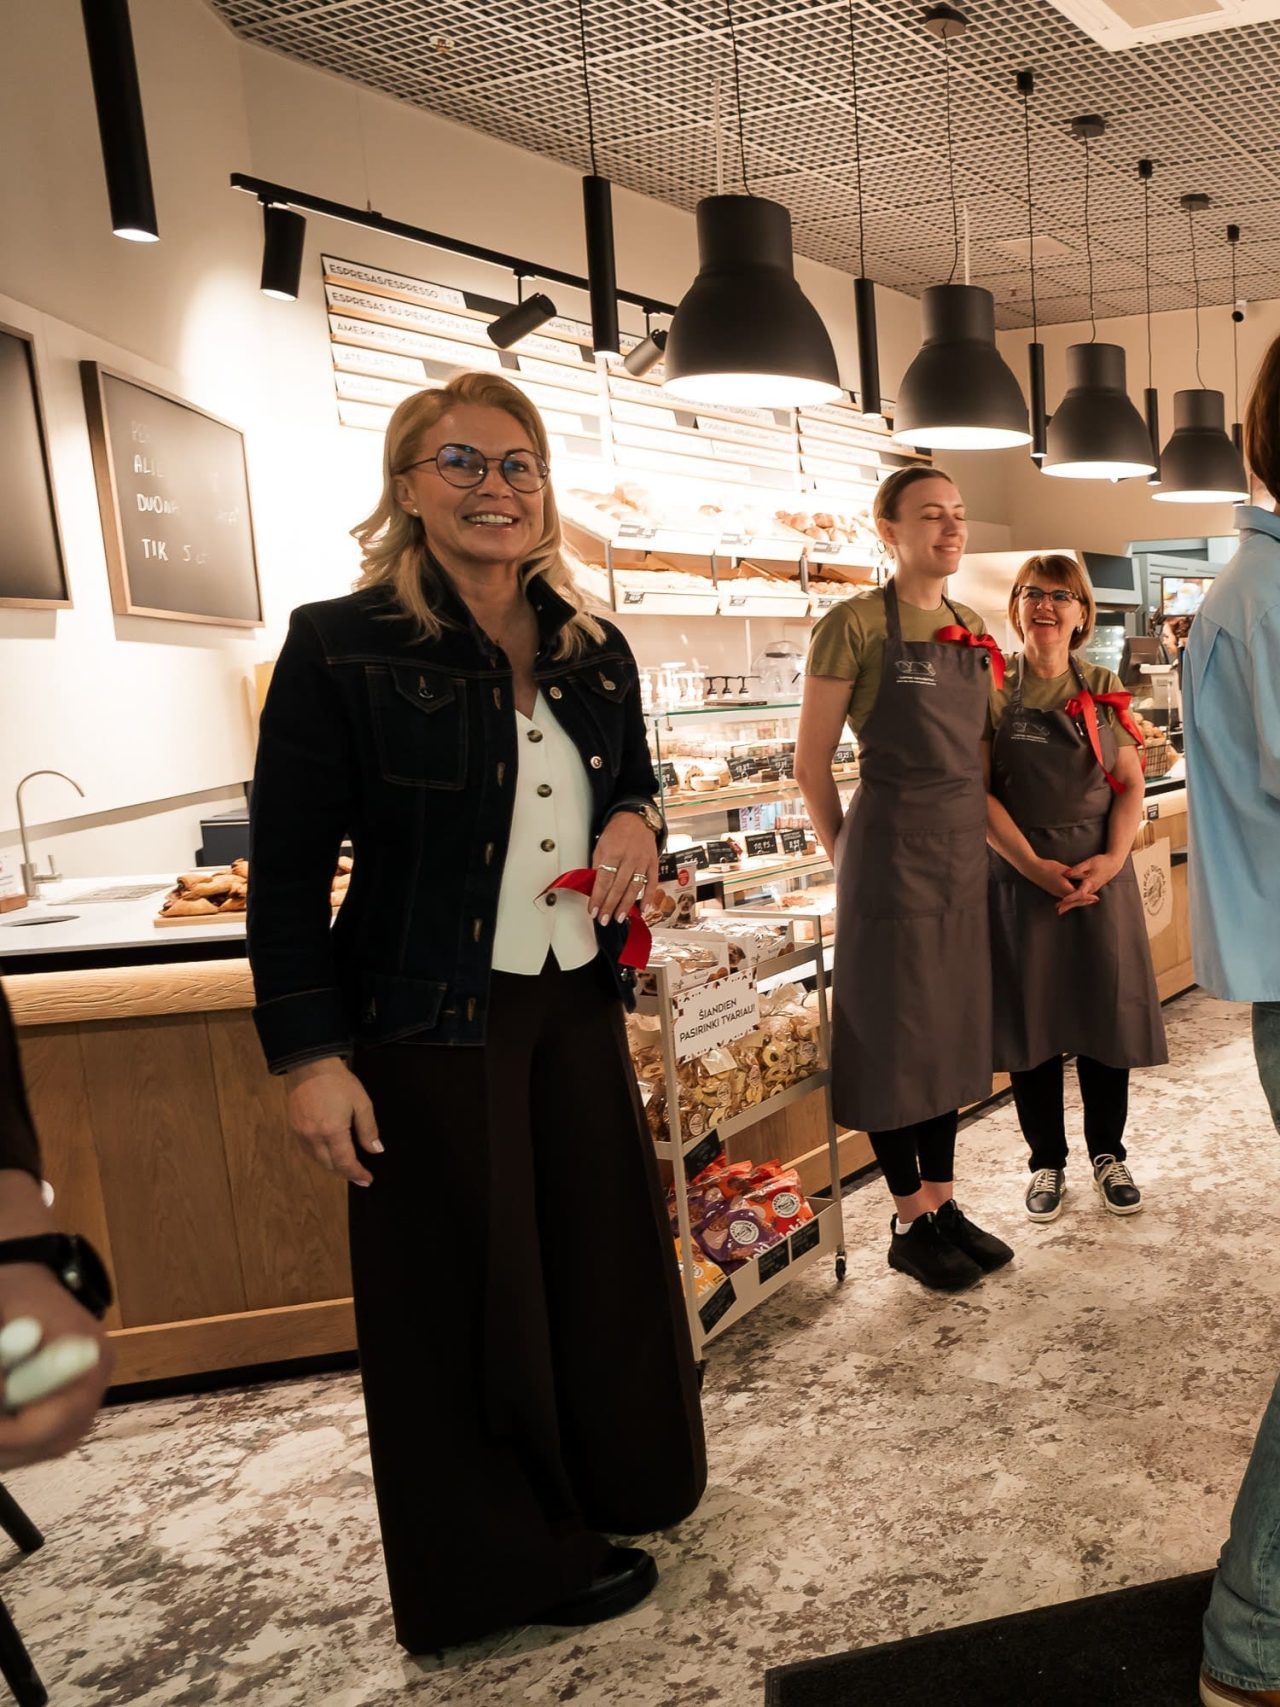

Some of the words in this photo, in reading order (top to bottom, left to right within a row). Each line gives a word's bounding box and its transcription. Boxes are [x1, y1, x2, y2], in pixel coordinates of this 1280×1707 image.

[141, 538, 169, 561] TIK
[698, 997, 737, 1021] ŠIANDIEN
[679, 1016, 720, 1043] PASIRINKI
[721, 1003, 756, 1026] TVARIAU!
